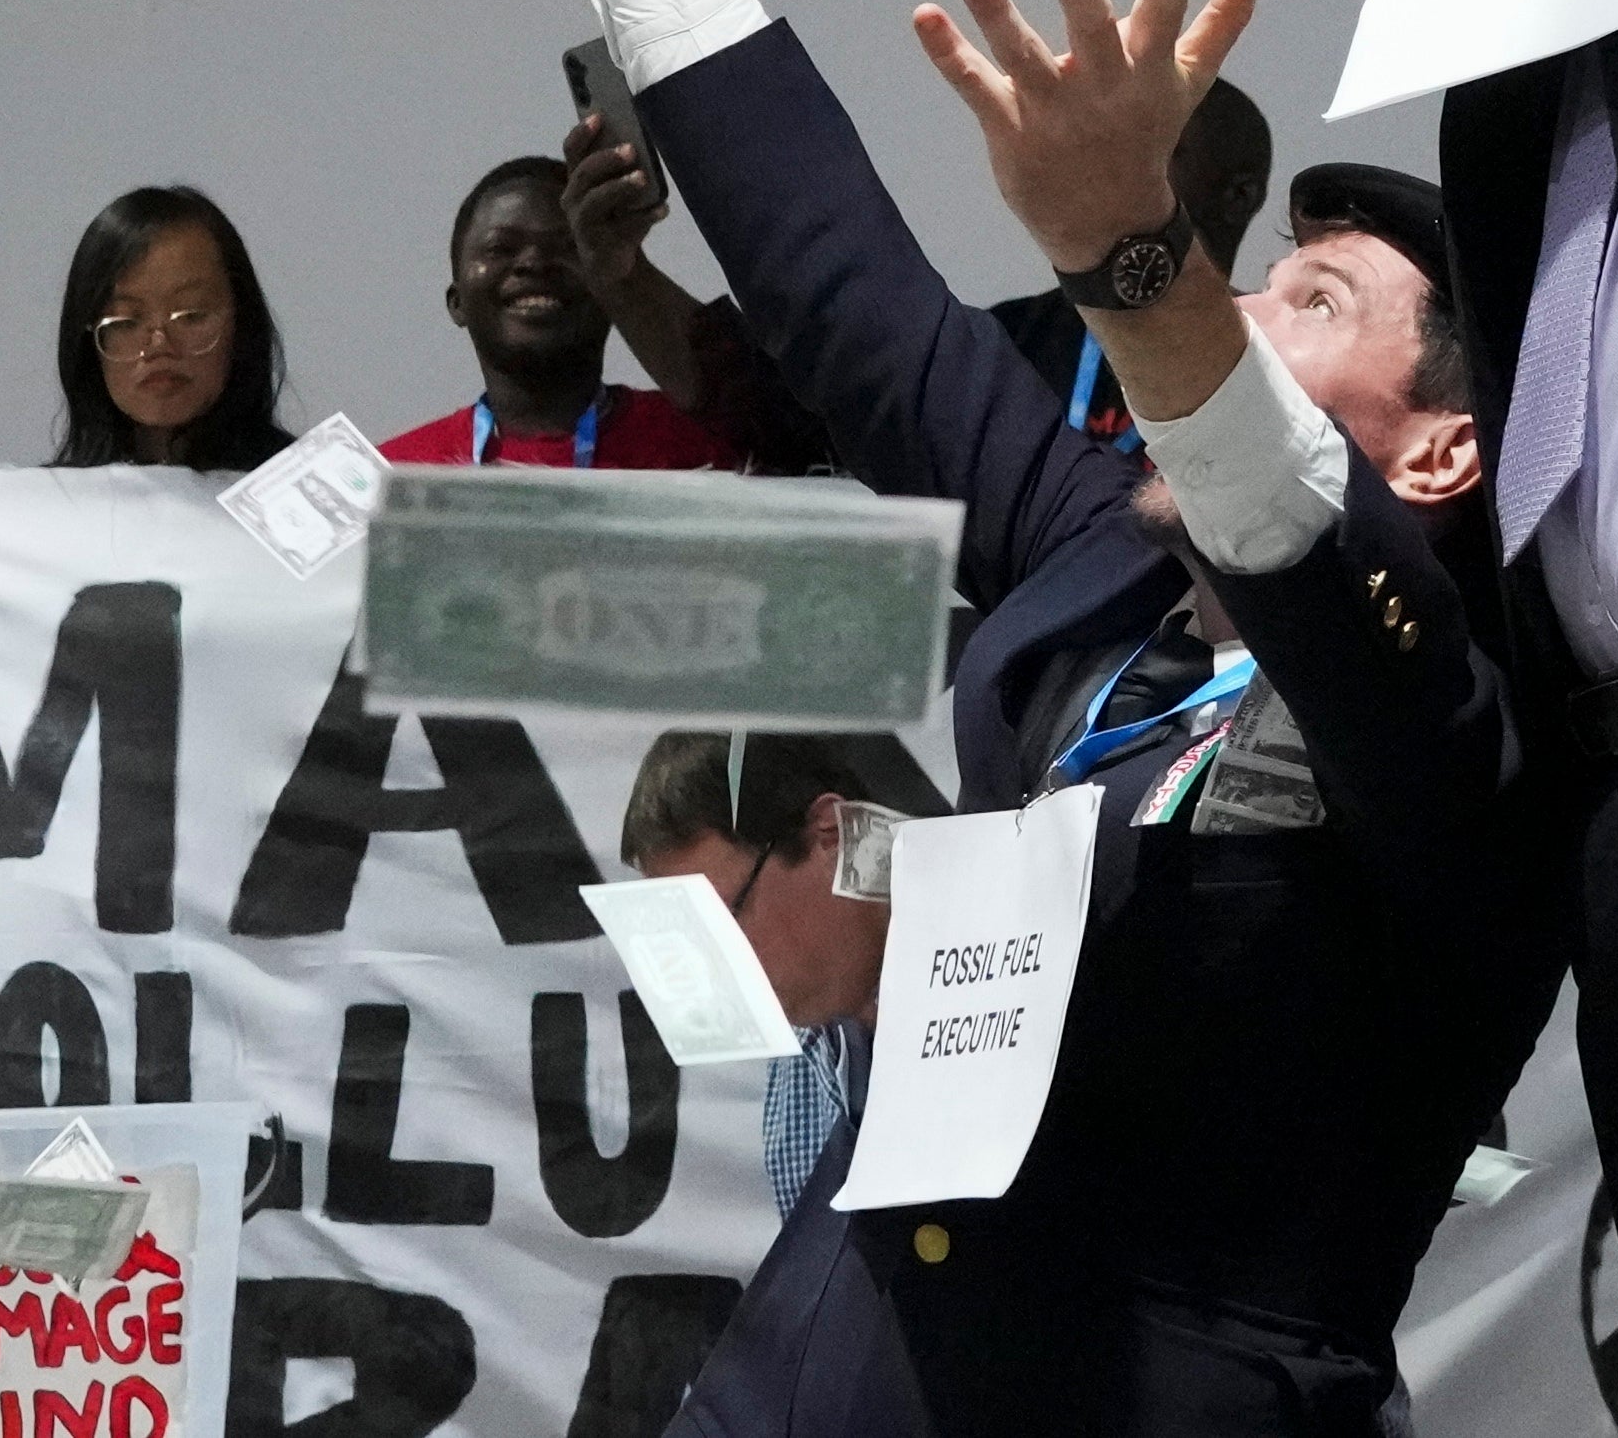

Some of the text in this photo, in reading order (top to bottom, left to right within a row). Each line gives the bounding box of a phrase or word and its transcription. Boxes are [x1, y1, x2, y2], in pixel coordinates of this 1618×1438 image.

[929, 932, 1043, 989] FOSSIL FUEL
[920, 1007, 1025, 1060] EXECUTIVE
